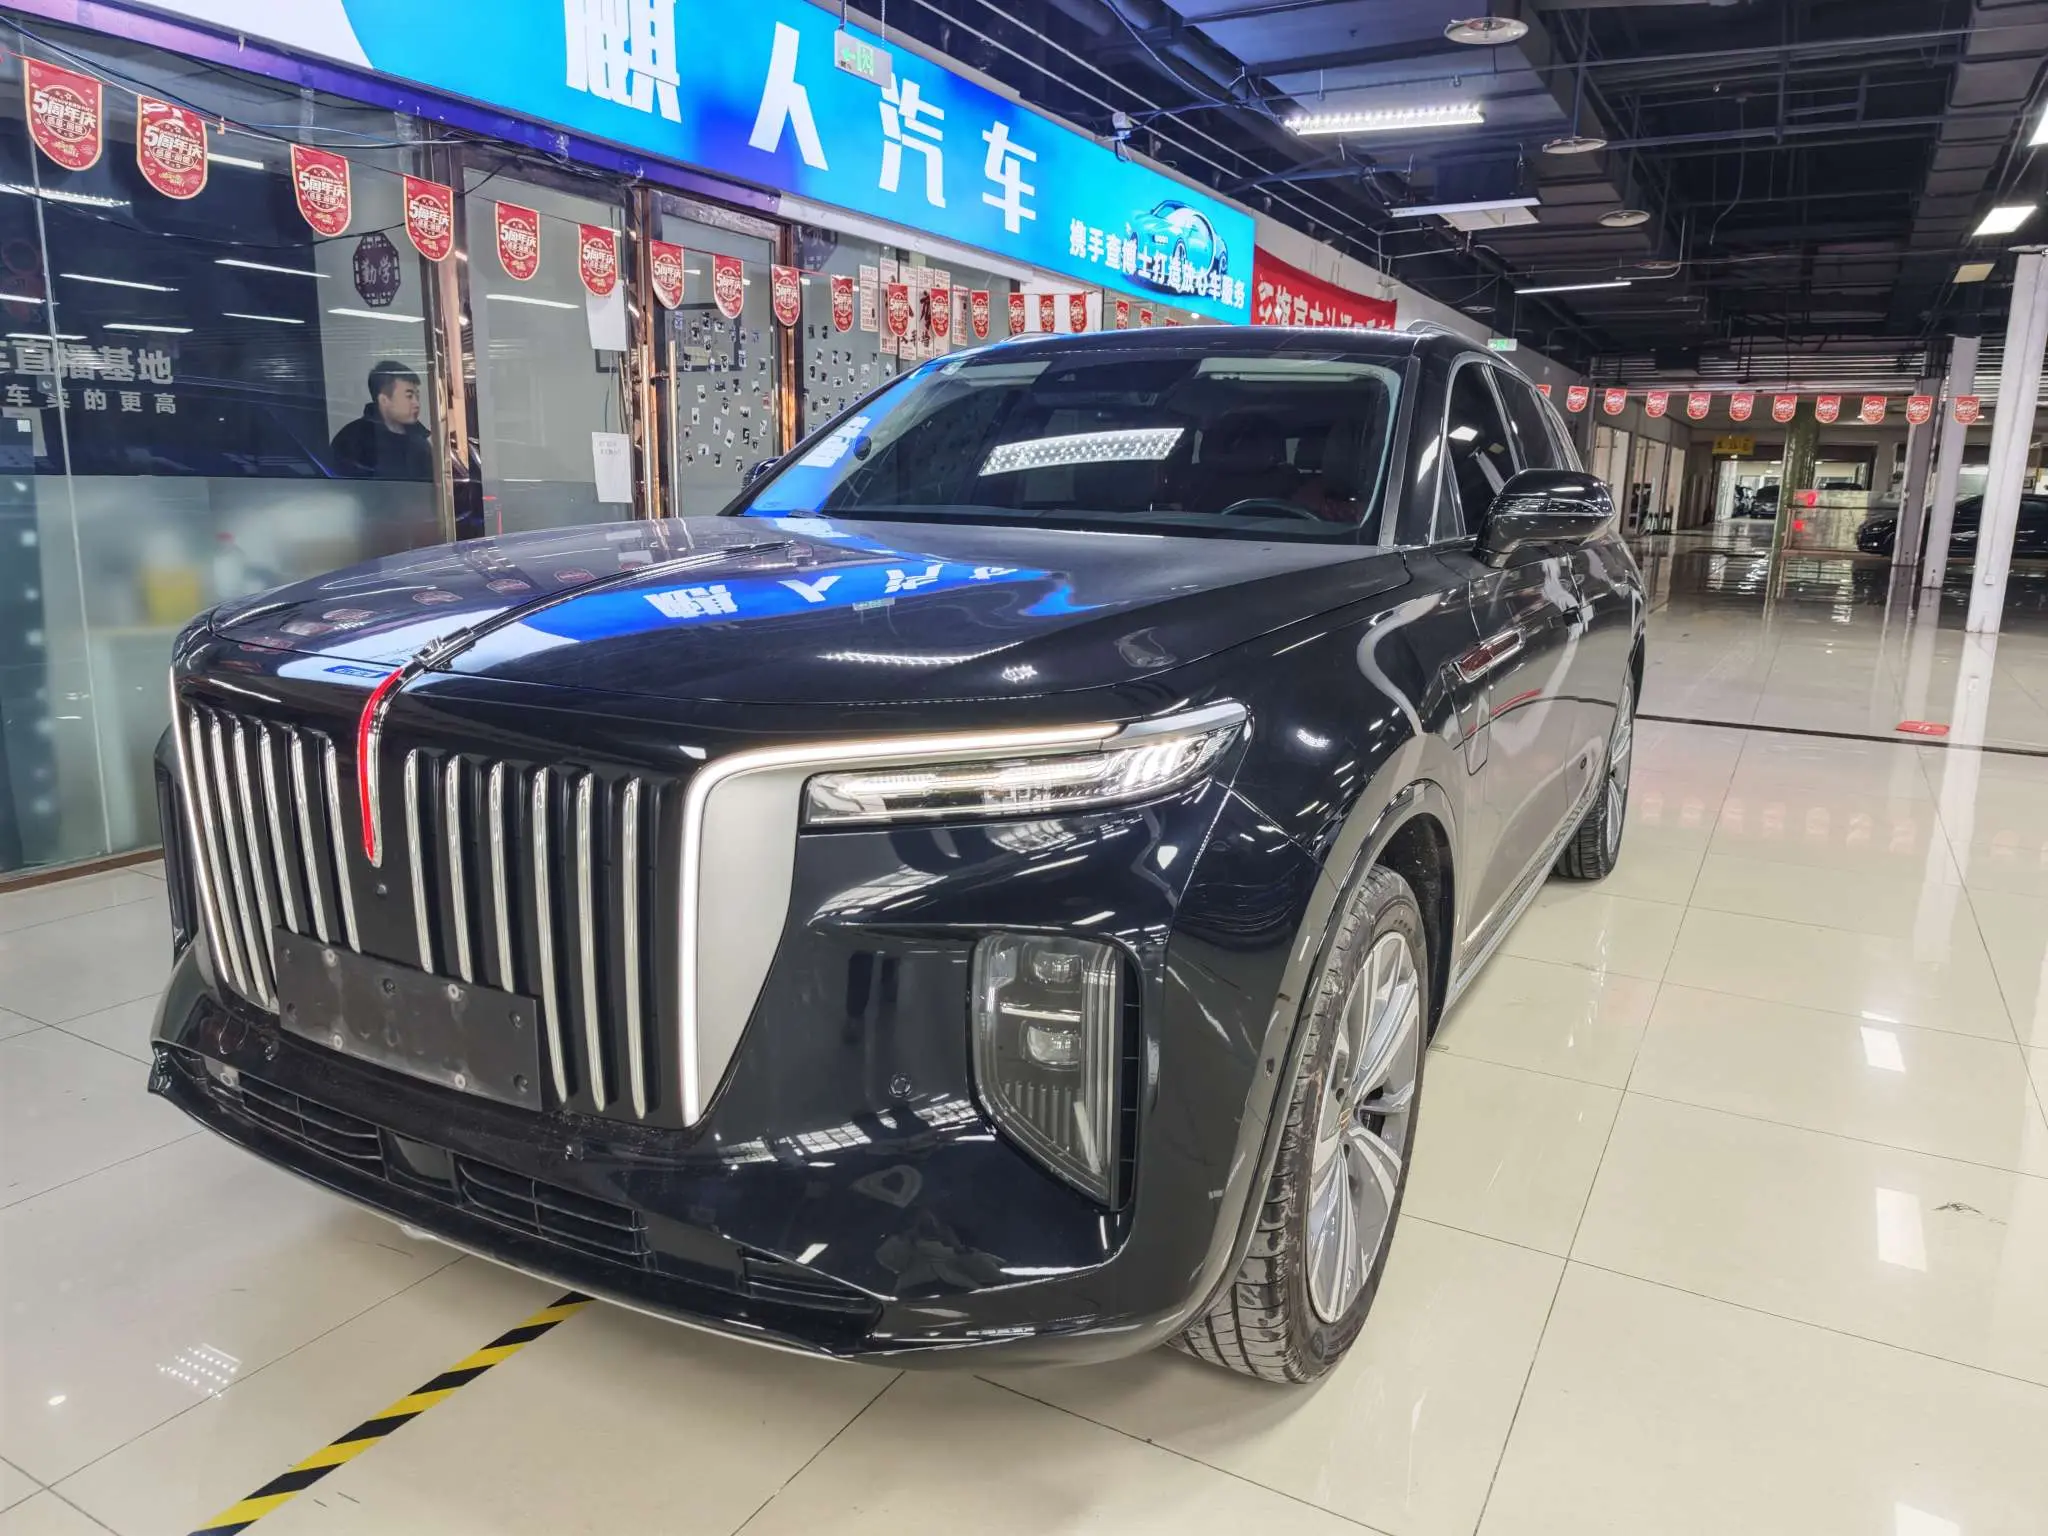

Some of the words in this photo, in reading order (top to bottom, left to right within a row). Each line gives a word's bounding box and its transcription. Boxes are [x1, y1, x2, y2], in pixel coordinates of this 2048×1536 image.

[31, 90, 97, 129] 5周年庆
[143, 125, 204, 160] 5周年庆
[298, 171, 346, 198] 5周年庆
[0, 340, 174, 385] 直播基地
